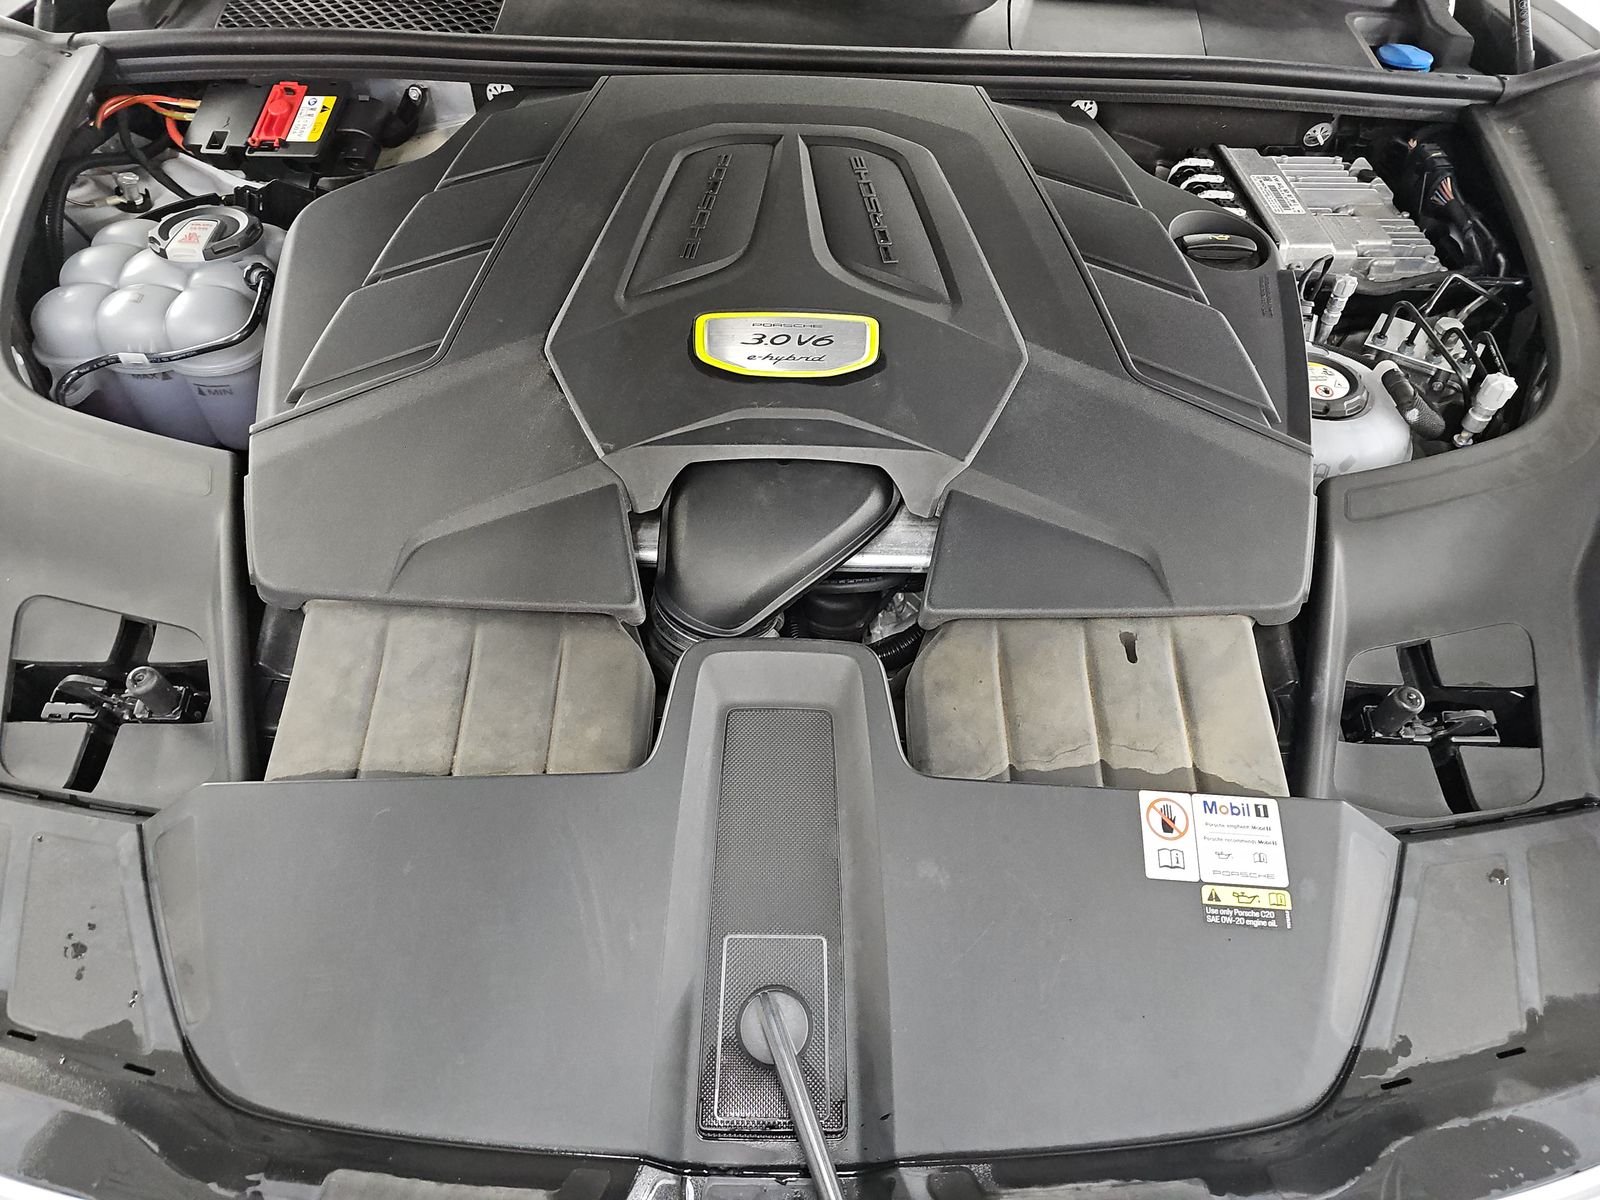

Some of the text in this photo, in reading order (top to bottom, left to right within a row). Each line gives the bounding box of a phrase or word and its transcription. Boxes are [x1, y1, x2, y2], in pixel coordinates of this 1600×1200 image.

[679, 152, 733, 260] PORSCHE
[848, 155, 900, 265] PORSCHE
[740, 332, 834, 348] 3.0 V6
[747, 353, 828, 366] e-hybrid
[207, 388, 234, 396] MIN
[1202, 800, 1270, 819] Mobil 1
[1212, 869, 1276, 880] PORSCHE
[1205, 906, 1276, 919] Use only Porsche C20
[1206, 915, 1220, 923] SAE
[1220, 916, 1245, 925] 0W-20
[1245, 918, 1267, 928] engine
[1267, 920, 1279, 928] oil.
